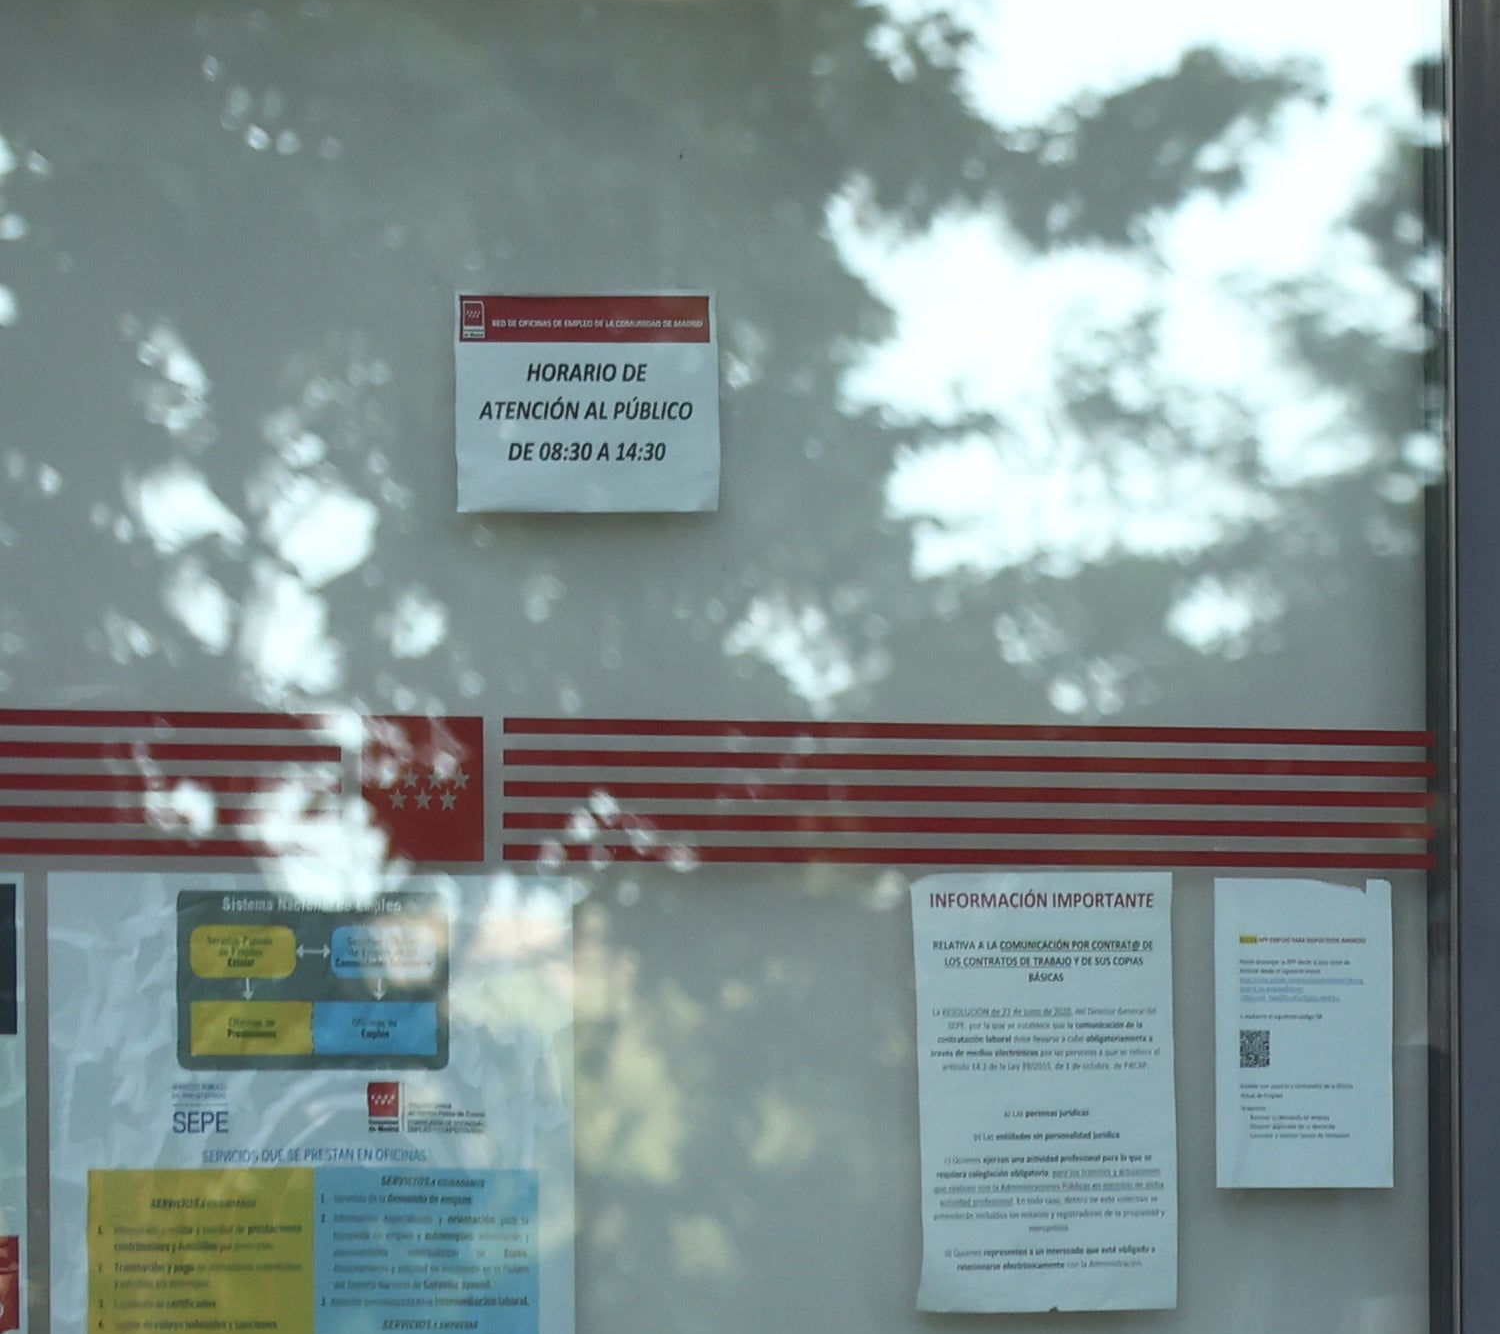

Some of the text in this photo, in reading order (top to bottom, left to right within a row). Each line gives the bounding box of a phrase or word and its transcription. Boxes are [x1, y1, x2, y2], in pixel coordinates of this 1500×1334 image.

[527, 363, 647, 382] HORARIO DE
[479, 396, 693, 421] ATENCIÓN AL PÚBLICO
[508, 442, 666, 461] DE 08:30 A 14:30
[222, 898, 274, 911] Sistema
[930, 889, 1154, 908] INFORMACIÓN IMPORTANTE
[933, 939, 1153, 951] RELATIVA A LA COMUNICACIÓN POR CONTRAT@ DE
[945, 957, 1143, 967] LOS CONTRATOS DE TRABAJO Y DE SUS COPIAS
[1029, 973, 1064, 982] BÁSICAS
[172, 1111, 229, 1134] SEPE
[202, 1147, 426, 1163] SERVICIOS QUE SE PRESTAN EN OFICINAS
